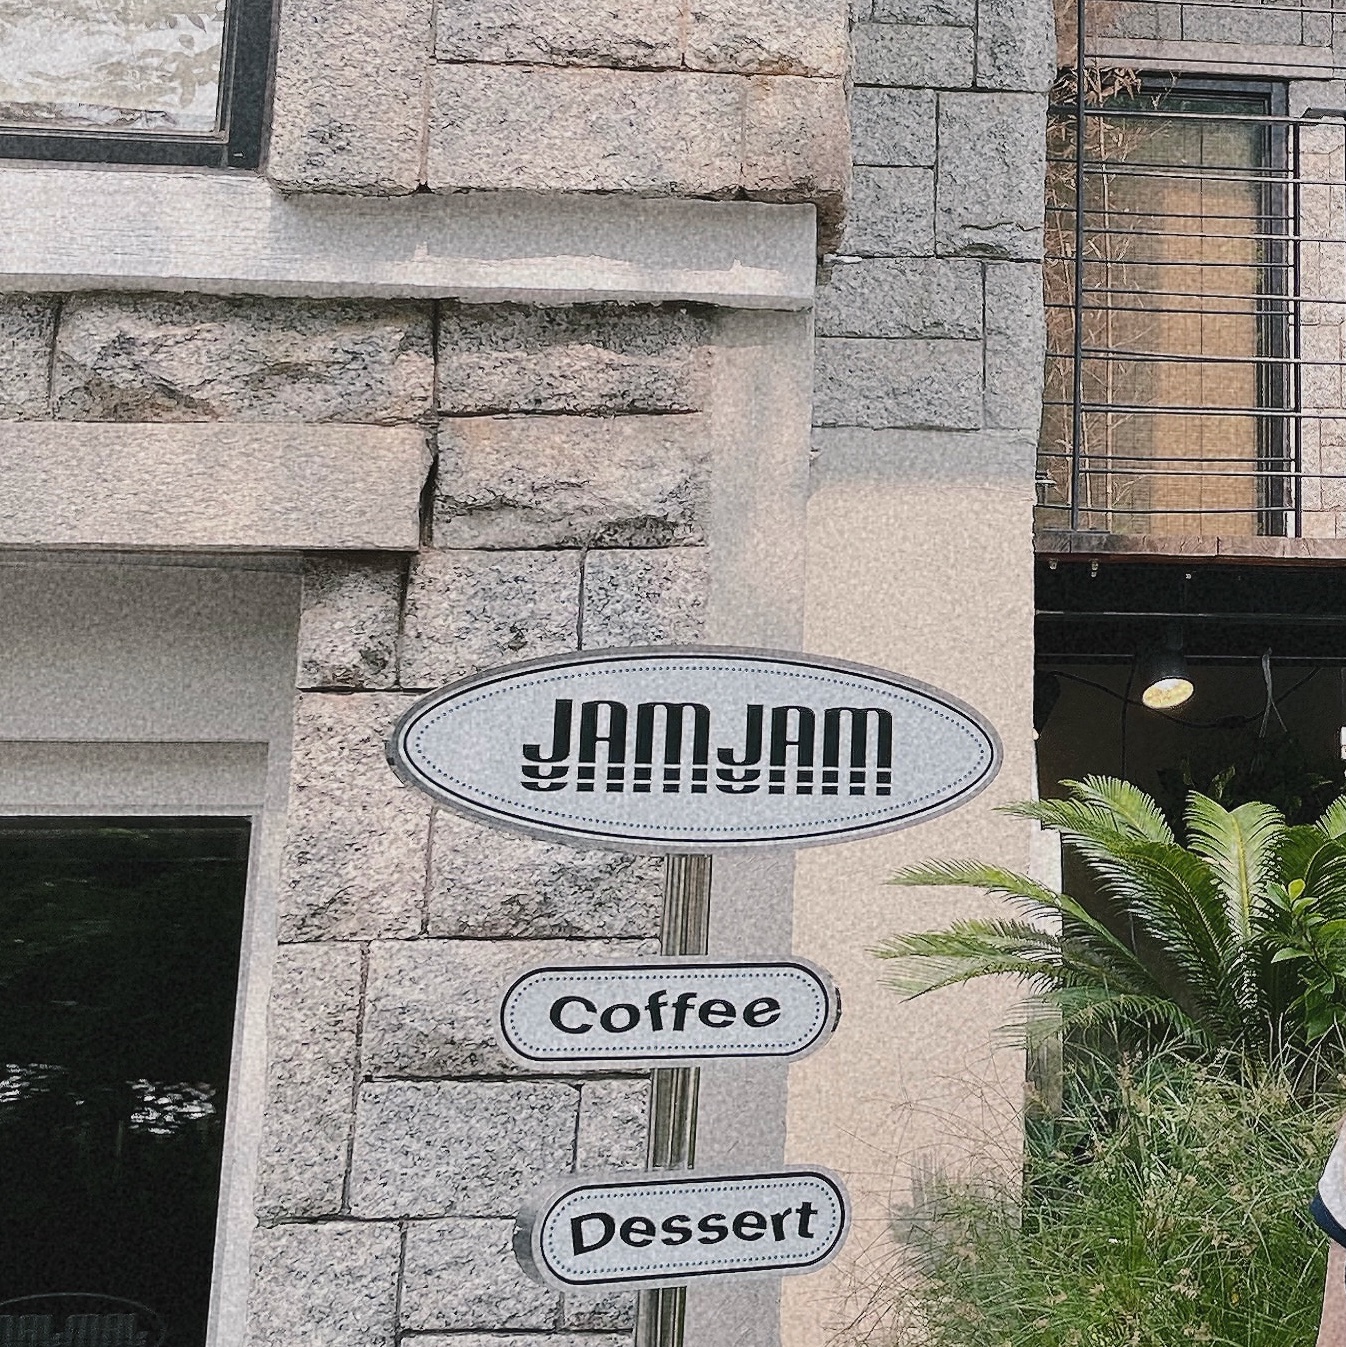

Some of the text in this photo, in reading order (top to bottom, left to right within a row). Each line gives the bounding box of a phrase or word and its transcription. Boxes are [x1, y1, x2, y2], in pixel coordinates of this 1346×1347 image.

[520, 698, 893, 796] JAMJAM
[548, 989, 782, 1034] Coffee
[570, 1201, 818, 1256] Dessert
